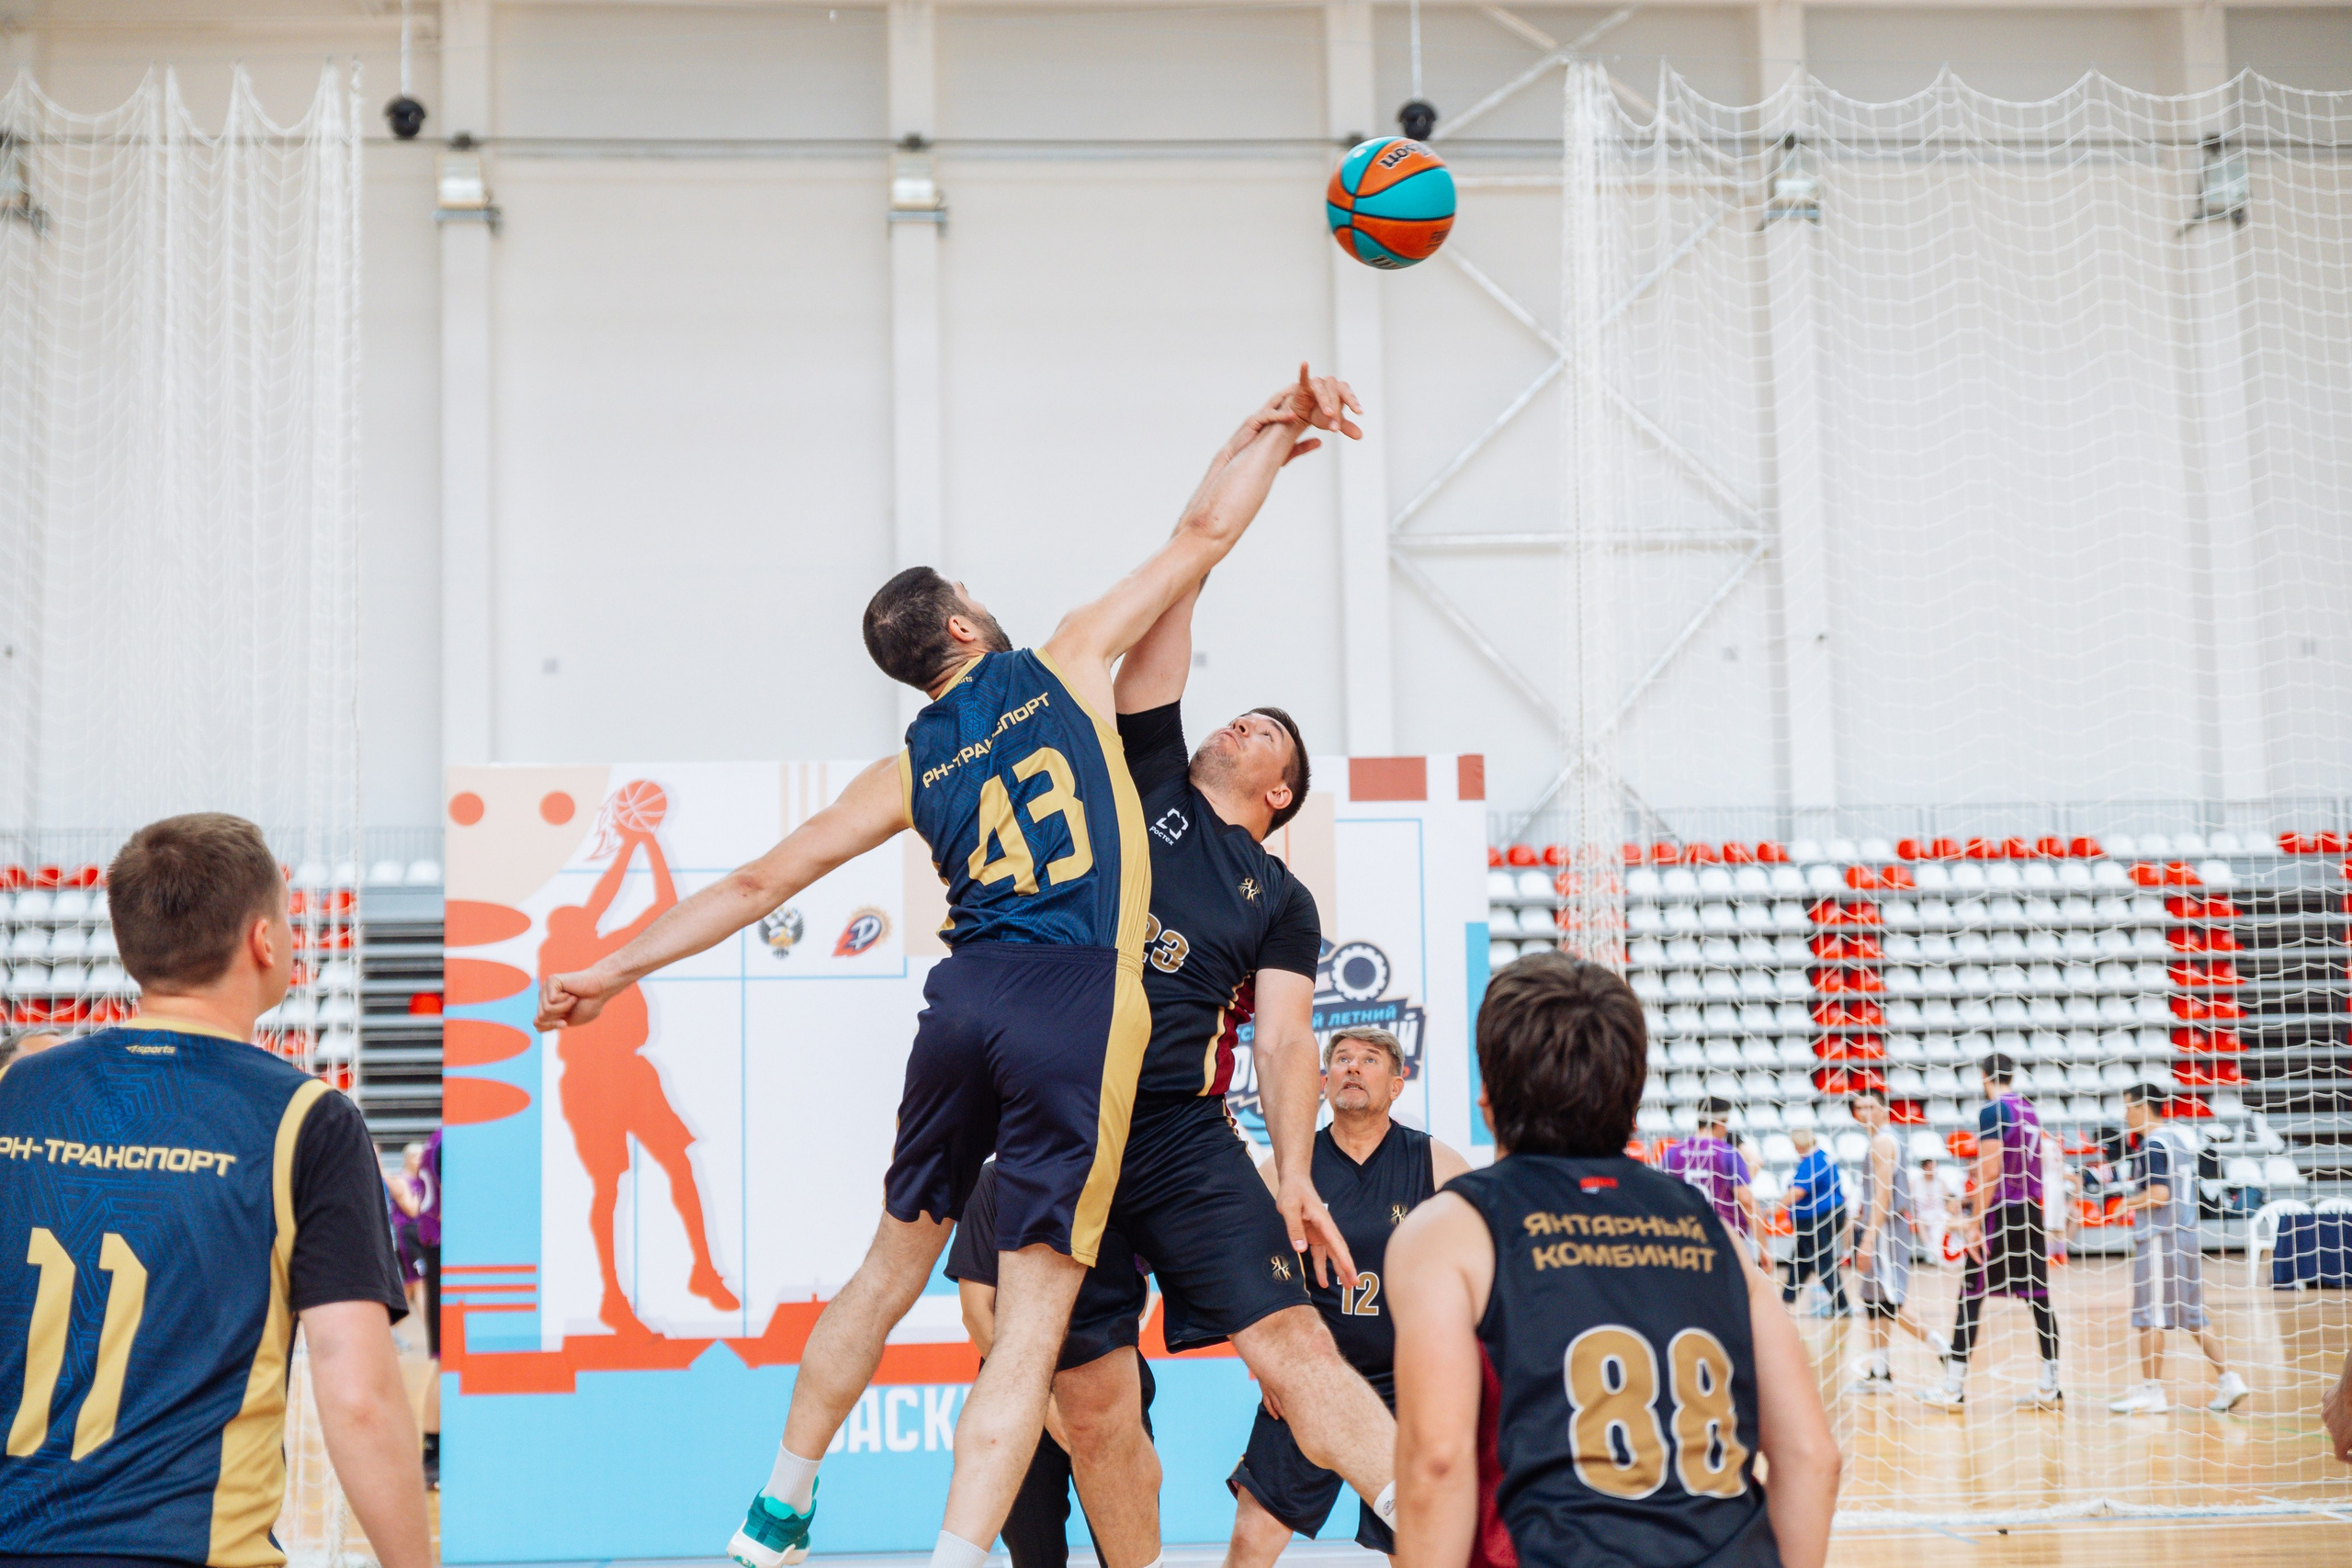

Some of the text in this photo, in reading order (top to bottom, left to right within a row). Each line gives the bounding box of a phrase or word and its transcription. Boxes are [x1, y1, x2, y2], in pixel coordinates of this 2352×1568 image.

[967, 747, 1093, 897] 43
[1328, 1004, 1396, 1028] ЛЕТНИЙ
[0, 1136, 237, 1177] РН-ТРАНСПОРТ
[1523, 1212, 1709, 1244] ЯНТАРНЫЙ
[1532, 1242, 1717, 1273] КОМБИНАТ
[1337, 1271, 1380, 1316] 12
[6, 1227, 148, 1462] 11
[825, 1386, 974, 1454] АСК
[1564, 1324, 1749, 1501] 88
